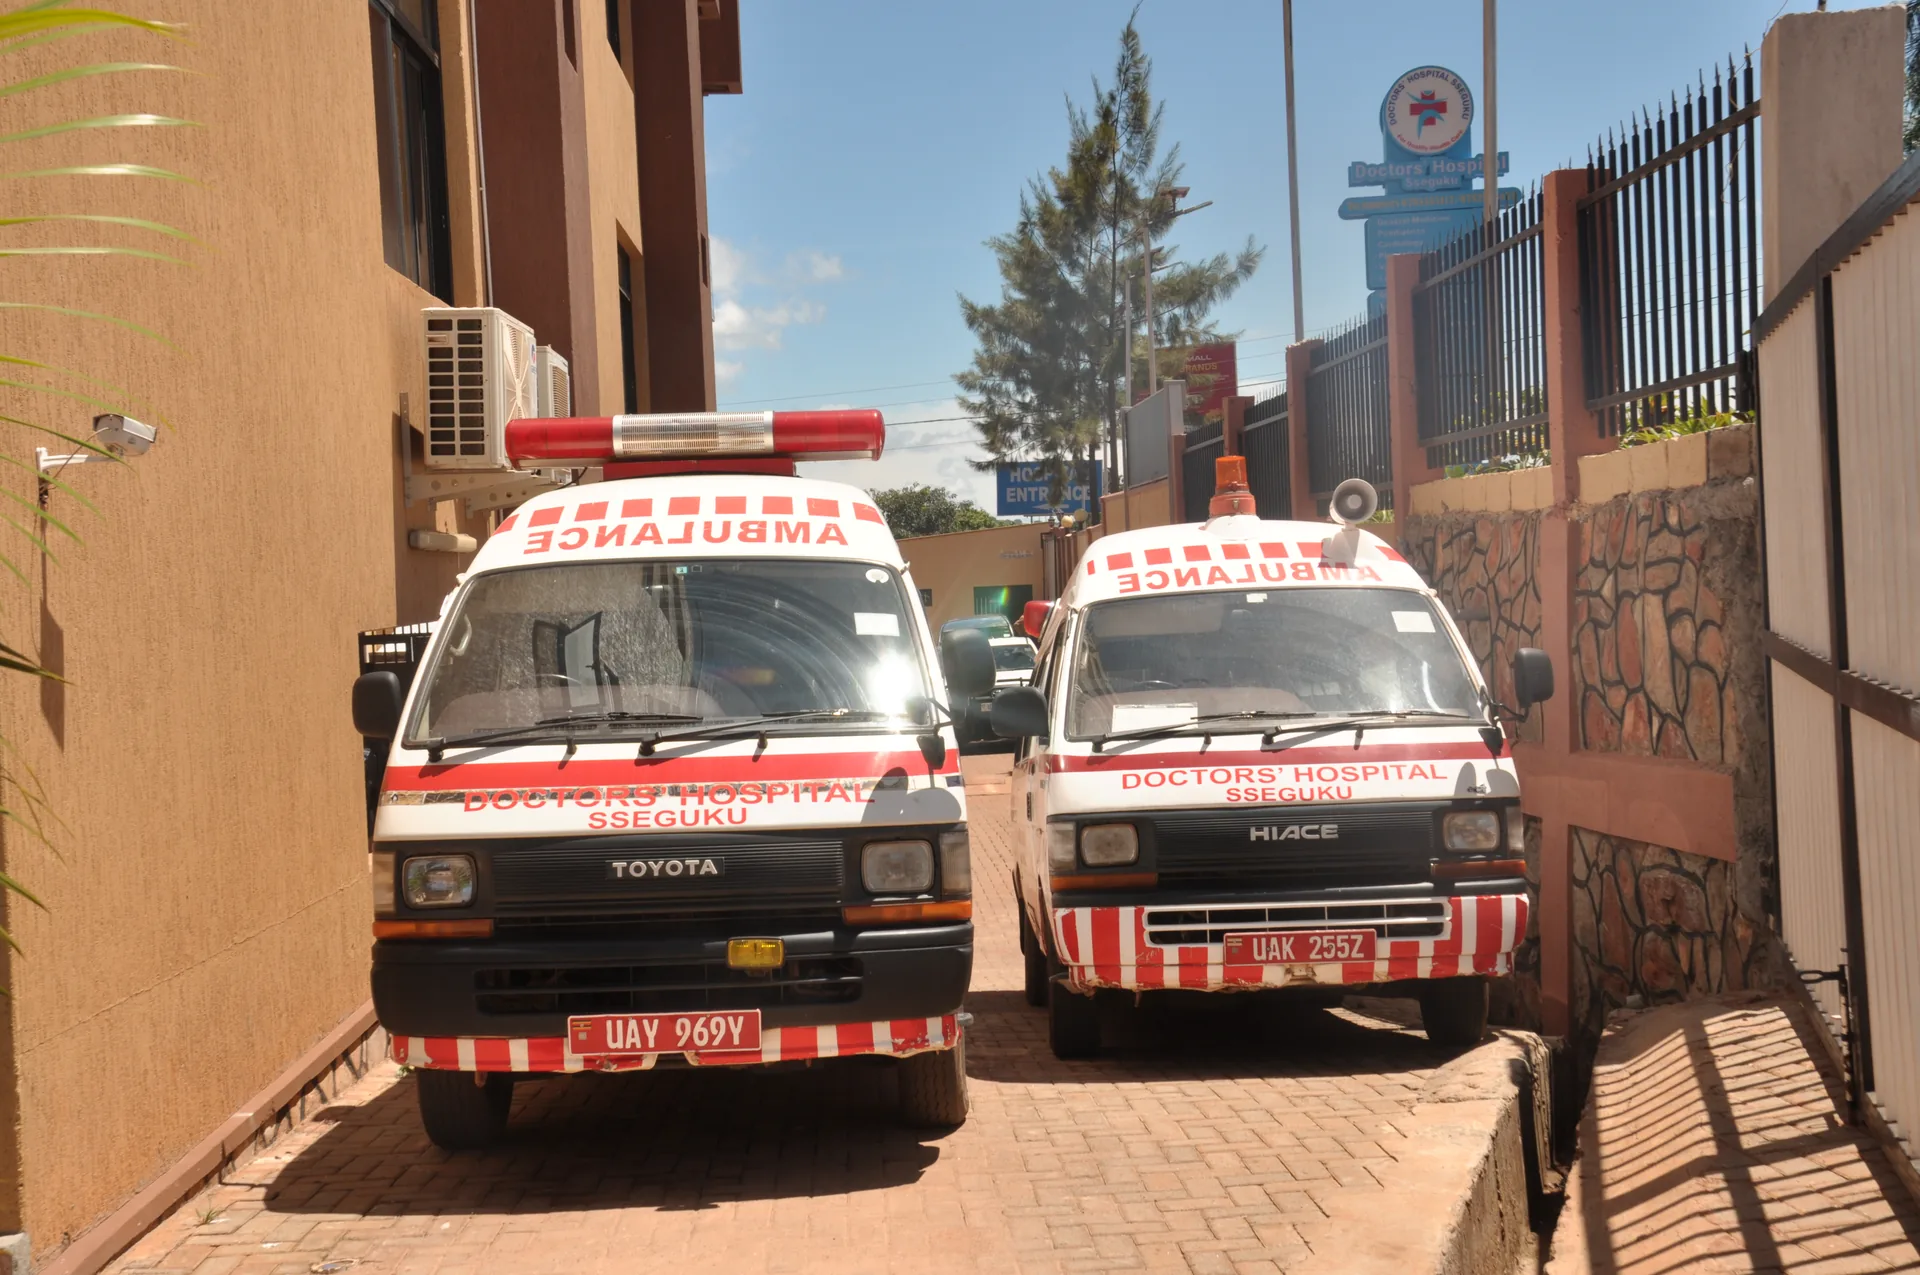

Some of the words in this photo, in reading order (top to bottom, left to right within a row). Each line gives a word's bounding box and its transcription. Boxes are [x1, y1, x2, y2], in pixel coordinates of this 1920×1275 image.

[1407, 70, 1449, 83] HOSPITAL
[1450, 79, 1470, 120] SSEGUKU
[1433, 154, 1506, 176] Hospil
[1405, 176, 1459, 188] Sseguku
[1006, 485, 1091, 502] ENTRNCE
[1121, 767, 1284, 790] DOCTORS'
[1294, 764, 1448, 783] HOSPITAL
[464, 785, 666, 812] DOCTORS'
[680, 782, 875, 806] HOSPITAL
[1226, 786, 1353, 802] SSEGUKU
[588, 808, 748, 829] SSEGUKU
[1250, 824, 1339, 841] HIACE
[612, 858, 718, 877] TOYOTA
[1253, 936, 1296, 961] UAK
[1309, 934, 1364, 960] 255Z
[606, 1018, 659, 1049] UAY
[675, 1016, 744, 1048] 969Y
